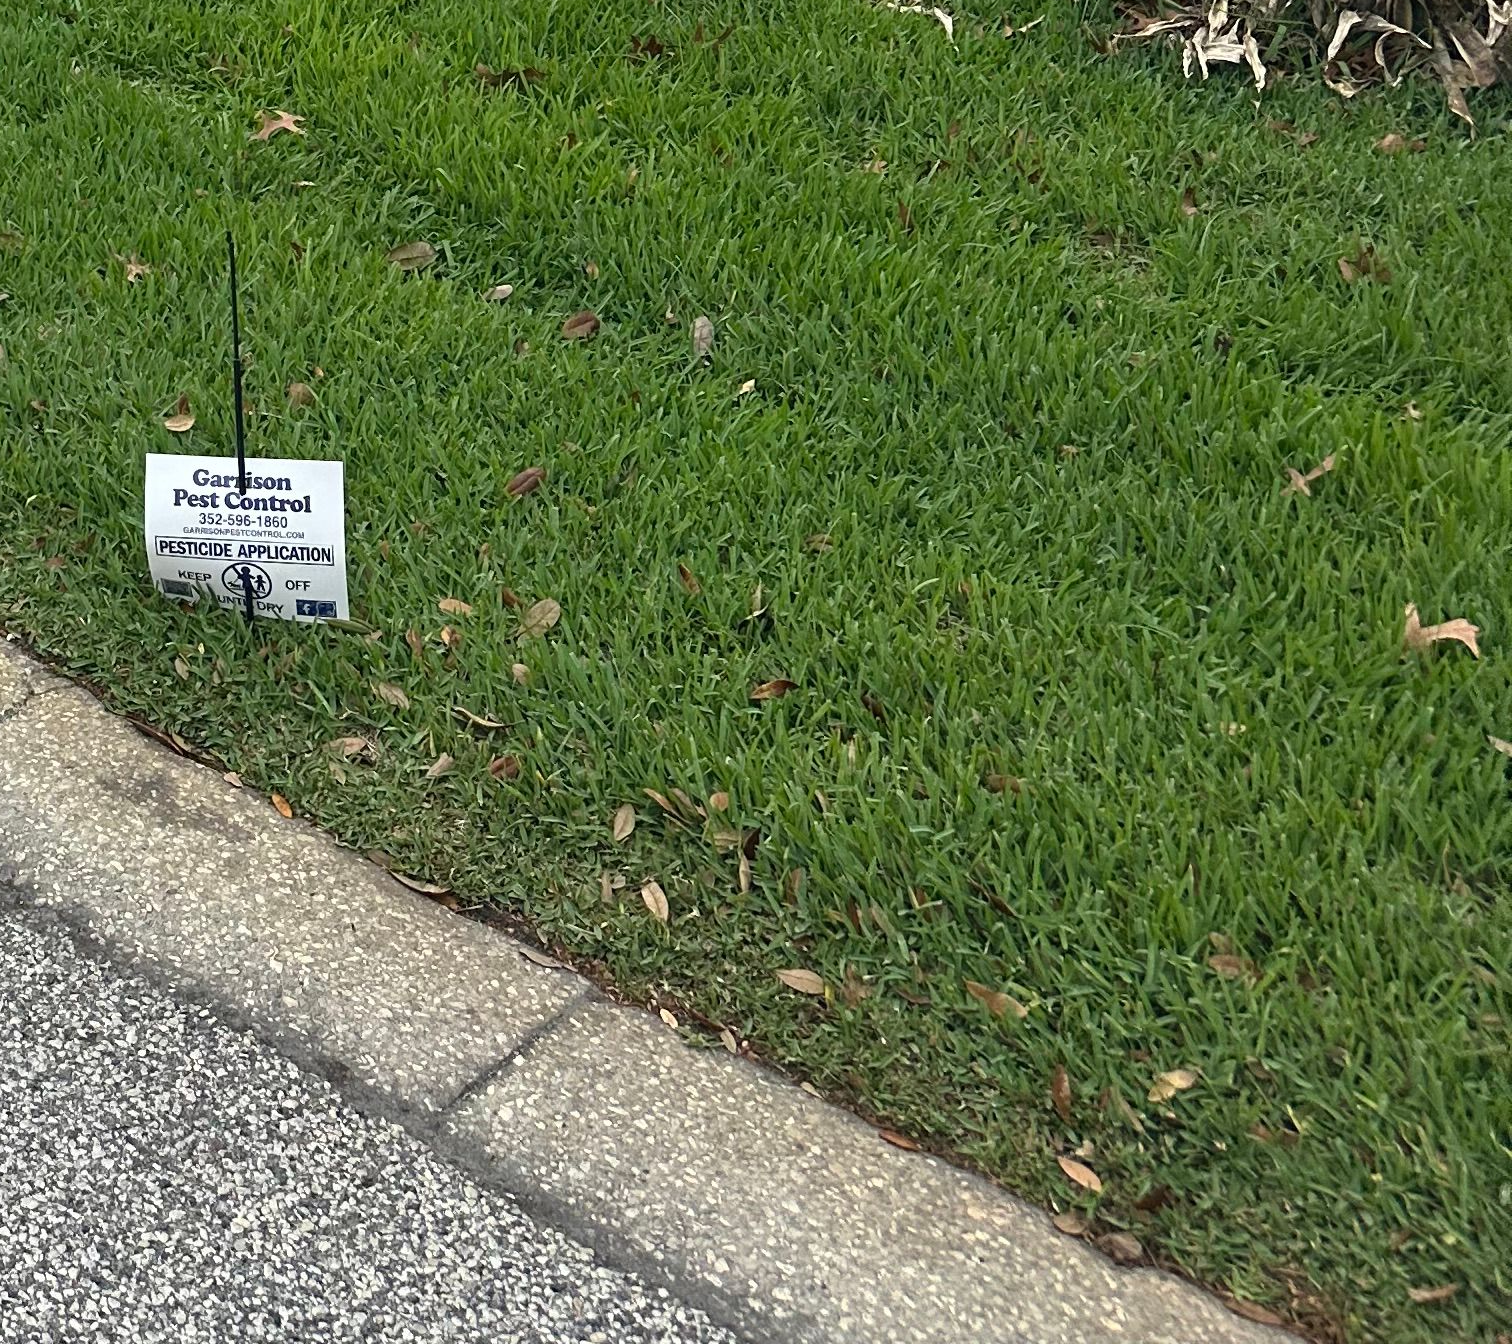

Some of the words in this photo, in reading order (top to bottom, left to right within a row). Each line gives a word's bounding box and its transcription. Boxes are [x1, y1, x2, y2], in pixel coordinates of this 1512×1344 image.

[173, 489, 220, 508] Pest
[224, 492, 312, 513] Control
[198, 513, 288, 528] 352-596-1860
[159, 540, 233, 558] PESTICIDE
[238, 544, 332, 562] APPLICATION
[178, 570, 212, 582] KEEP
[285, 579, 311, 591] OFF
[217, 594, 249, 607] UNTI
[257, 601, 284, 613] DRY
